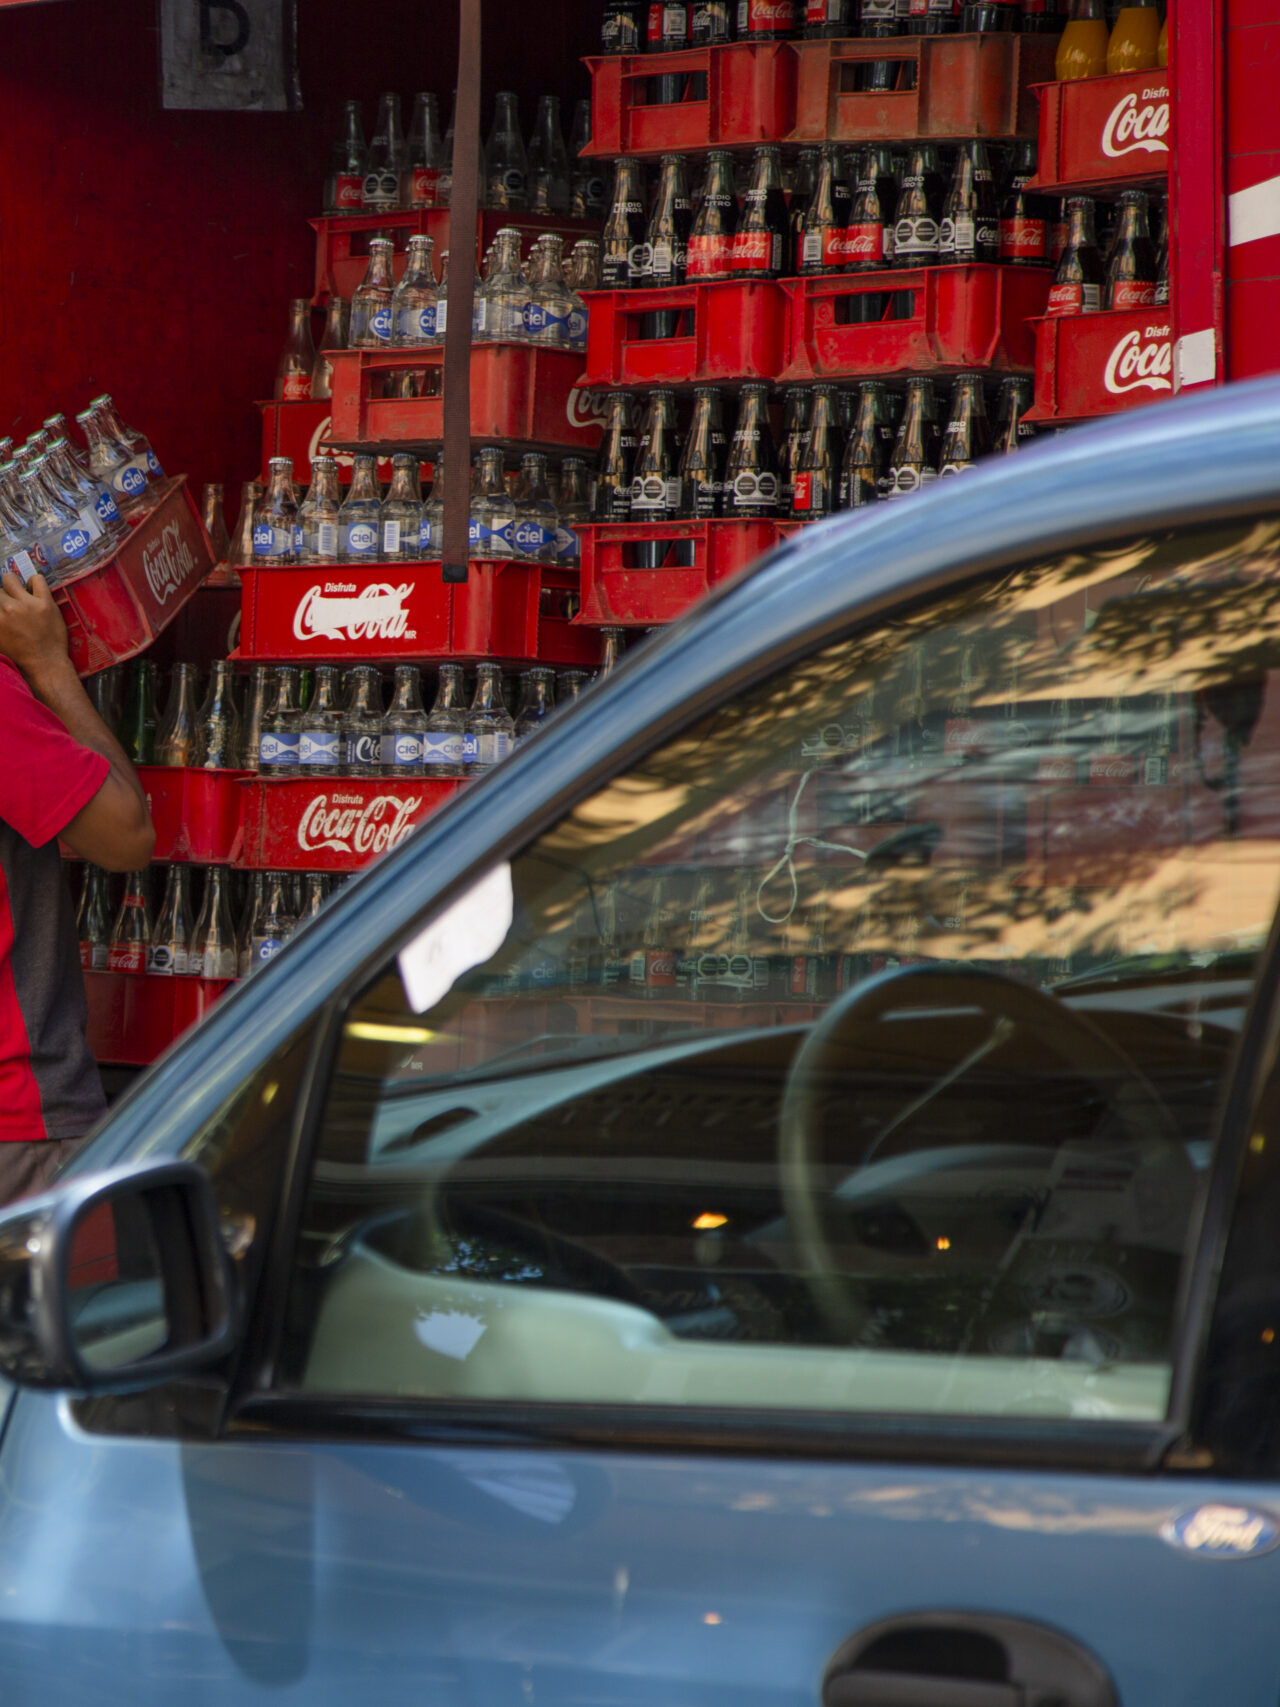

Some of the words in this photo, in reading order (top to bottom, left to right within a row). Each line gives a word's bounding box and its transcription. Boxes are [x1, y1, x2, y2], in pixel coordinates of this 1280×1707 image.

[122, 469, 145, 491] ciel
[351, 528, 373, 544] ciel
[516, 524, 544, 543] ciel
[61, 532, 89, 555] ciel
[324, 582, 357, 593] Disfruta
[398, 742, 420, 755] ciel
[332, 793, 364, 804] Disfruta
